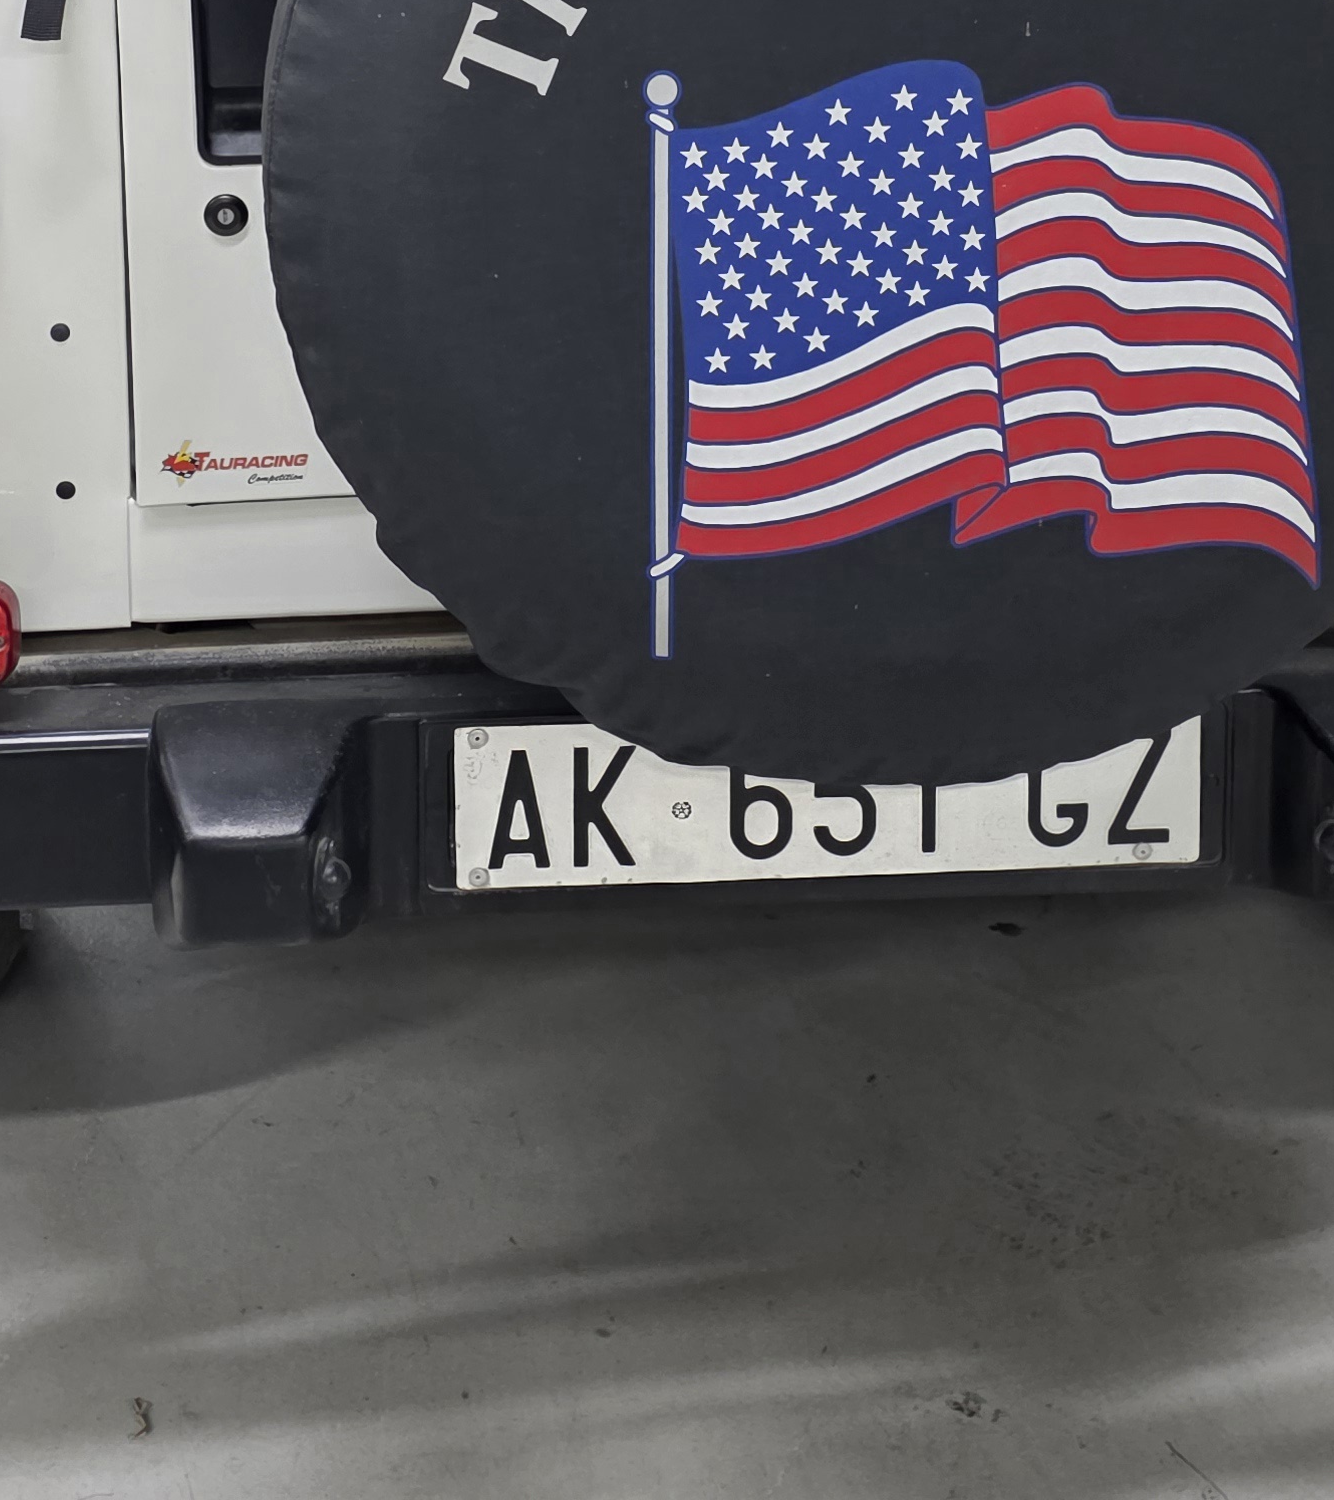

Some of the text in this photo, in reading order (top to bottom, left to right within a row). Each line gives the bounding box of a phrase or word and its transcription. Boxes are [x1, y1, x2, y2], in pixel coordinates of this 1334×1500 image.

[194, 450, 309, 472] TAURACING
[247, 473, 304, 485] Competition
[488, 745, 637, 870] AK
